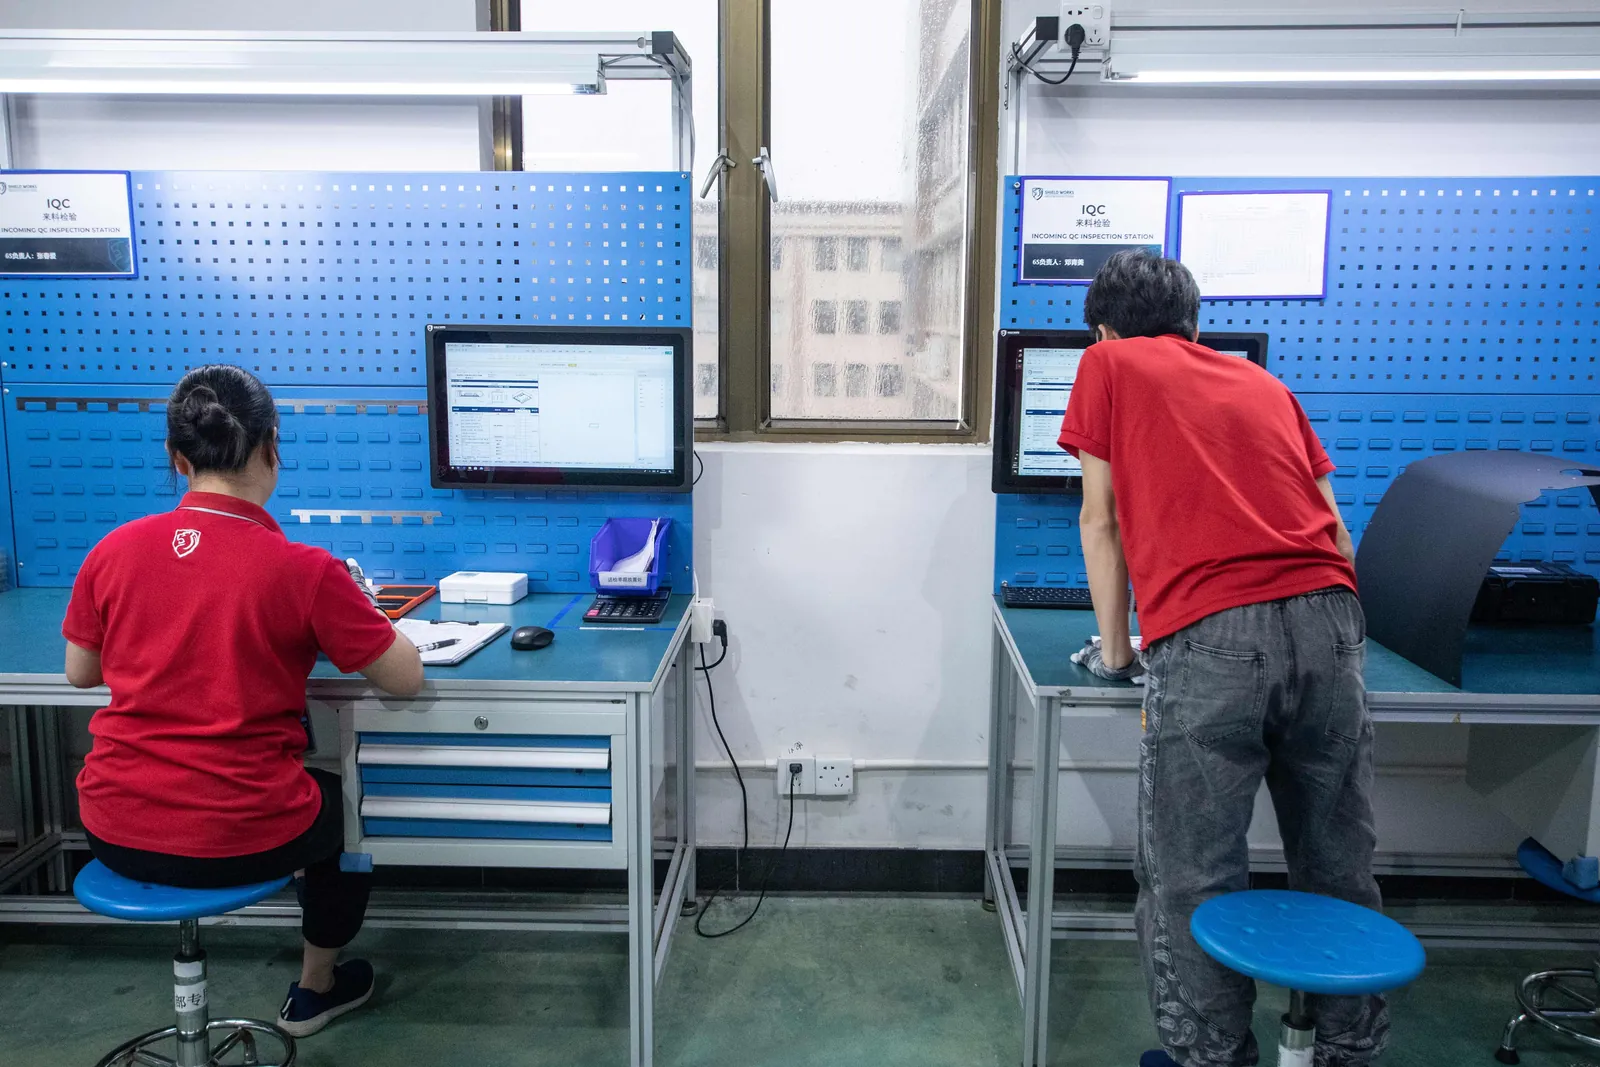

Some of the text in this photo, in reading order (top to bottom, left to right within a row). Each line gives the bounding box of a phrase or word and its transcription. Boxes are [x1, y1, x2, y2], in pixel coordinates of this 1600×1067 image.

[47, 199, 70, 210] IQC
[1082, 205, 1106, 216] IQC
[43, 212, 77, 221] 来料检验
[1076, 219, 1111, 228] 来料检验
